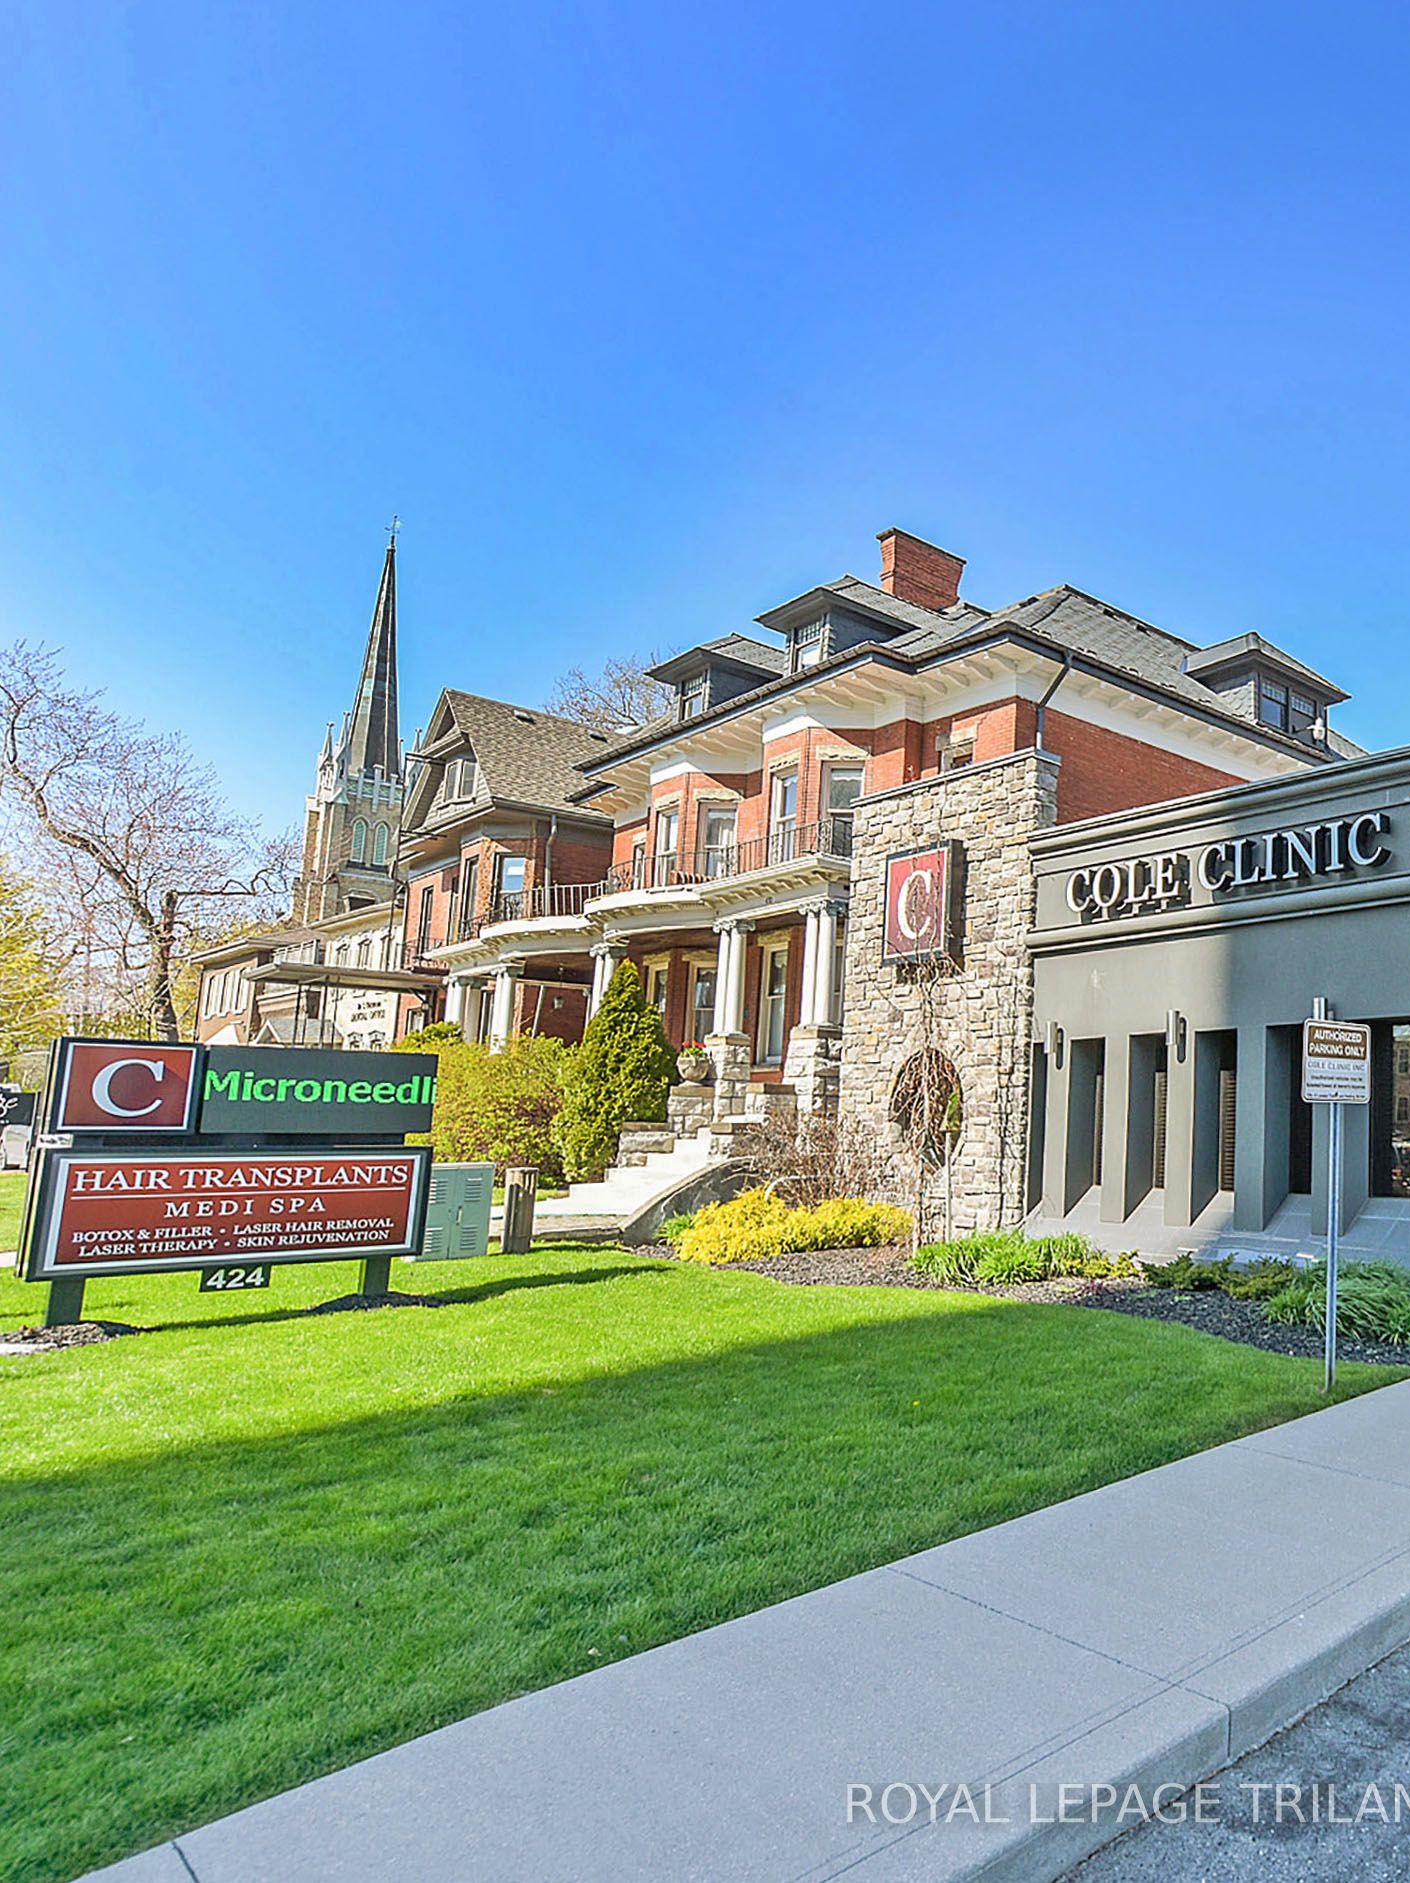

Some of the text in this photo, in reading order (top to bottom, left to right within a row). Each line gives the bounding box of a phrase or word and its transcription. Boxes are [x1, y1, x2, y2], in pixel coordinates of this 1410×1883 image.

[1065, 812, 1385, 913] COLE CLINIC
[896, 868, 934, 941] C
[1309, 1043, 1365, 1056] PARKING ONLY
[1314, 1030, 1362, 1043] AUTHORIZED
[90, 1058, 164, 1118] C
[72, 1165, 409, 1192] HAIR TRANSPLANTS
[163, 1197, 326, 1218] MEDI SPA
[72, 1217, 394, 1243] BOTOX & FILLER LASER HAIR REMOVAL
[78, 1229, 390, 1257] LASER THERAPY SKIN REJUVENATION
[206, 1267, 265, 1289] 424
